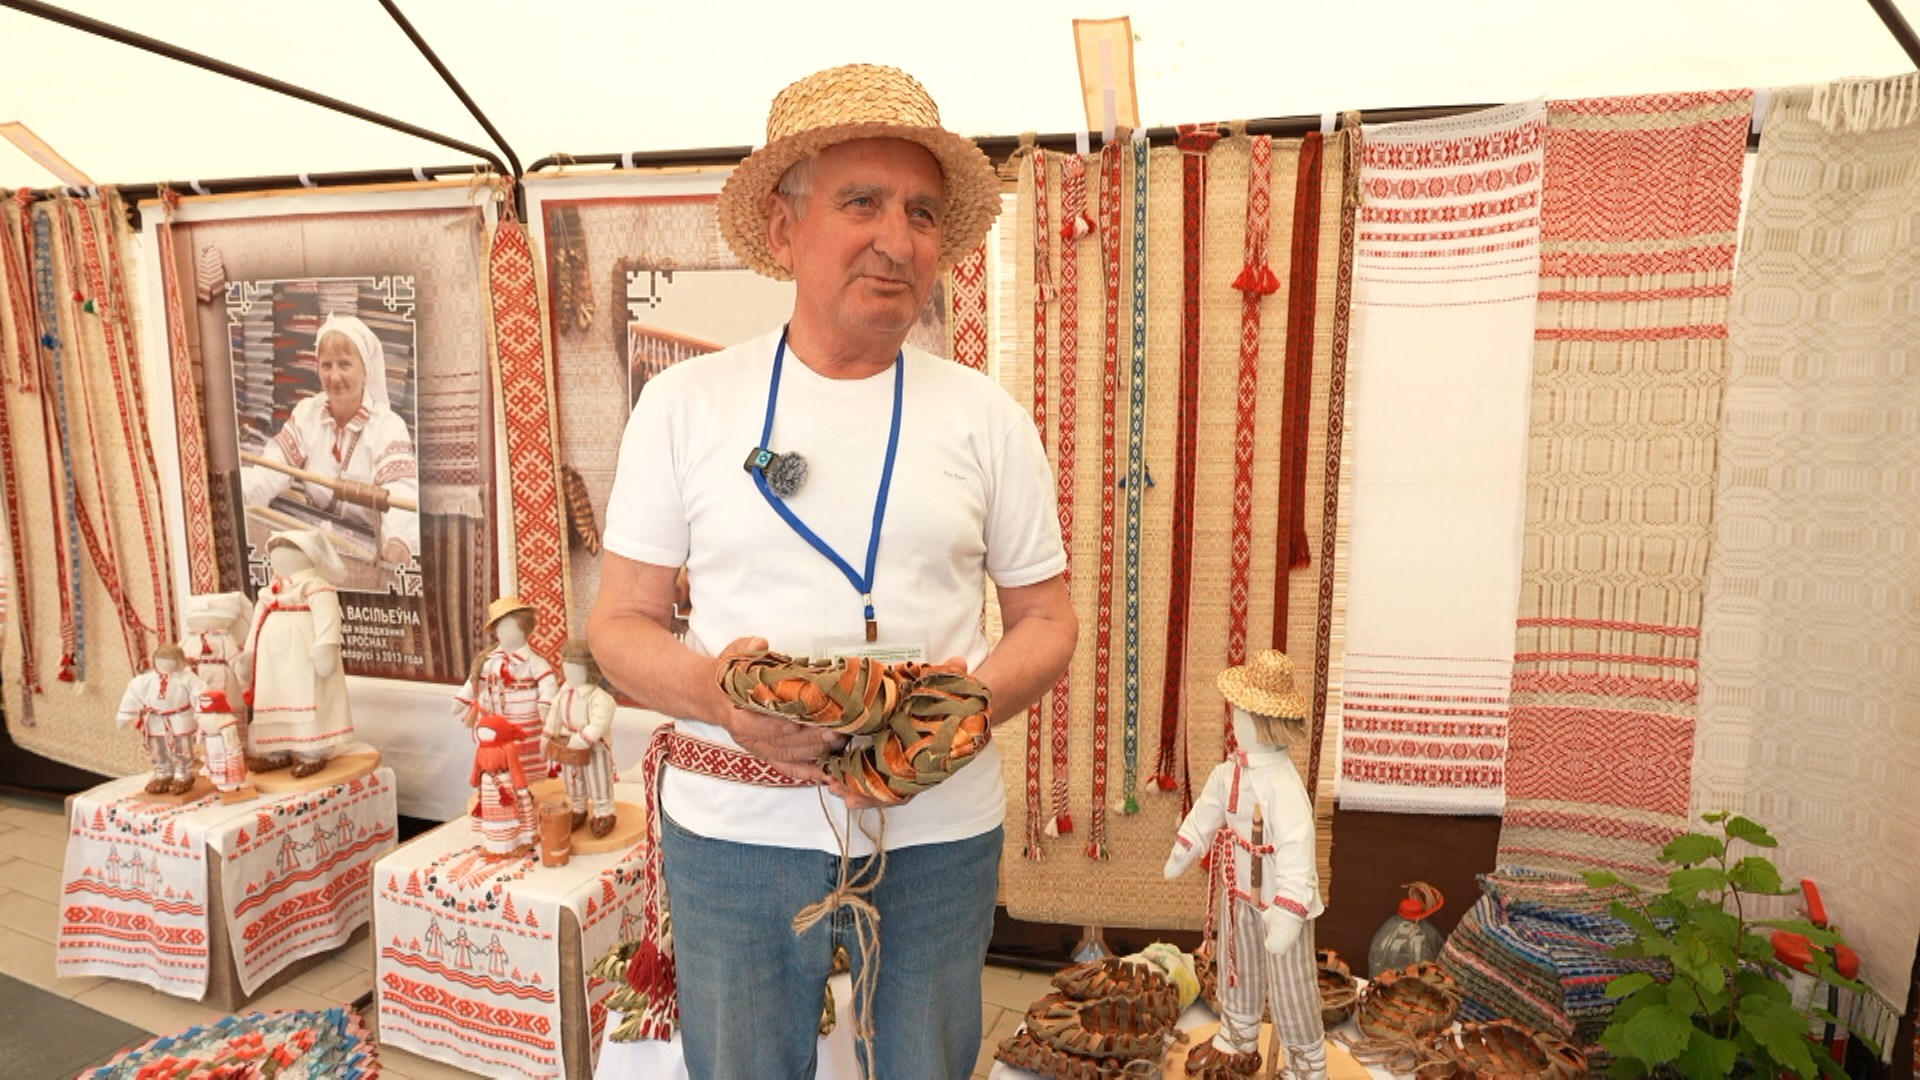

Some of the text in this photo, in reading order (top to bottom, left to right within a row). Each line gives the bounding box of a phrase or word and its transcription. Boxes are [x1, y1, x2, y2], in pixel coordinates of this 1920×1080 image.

[346, 605, 421, 625] ВАСІЛЬЕЎНА
[346, 635, 388, 648] КРОСНАХ
[342, 650, 374, 662] еларусі
[382, 650, 402, 663] 2013
[403, 654, 424, 665] года
